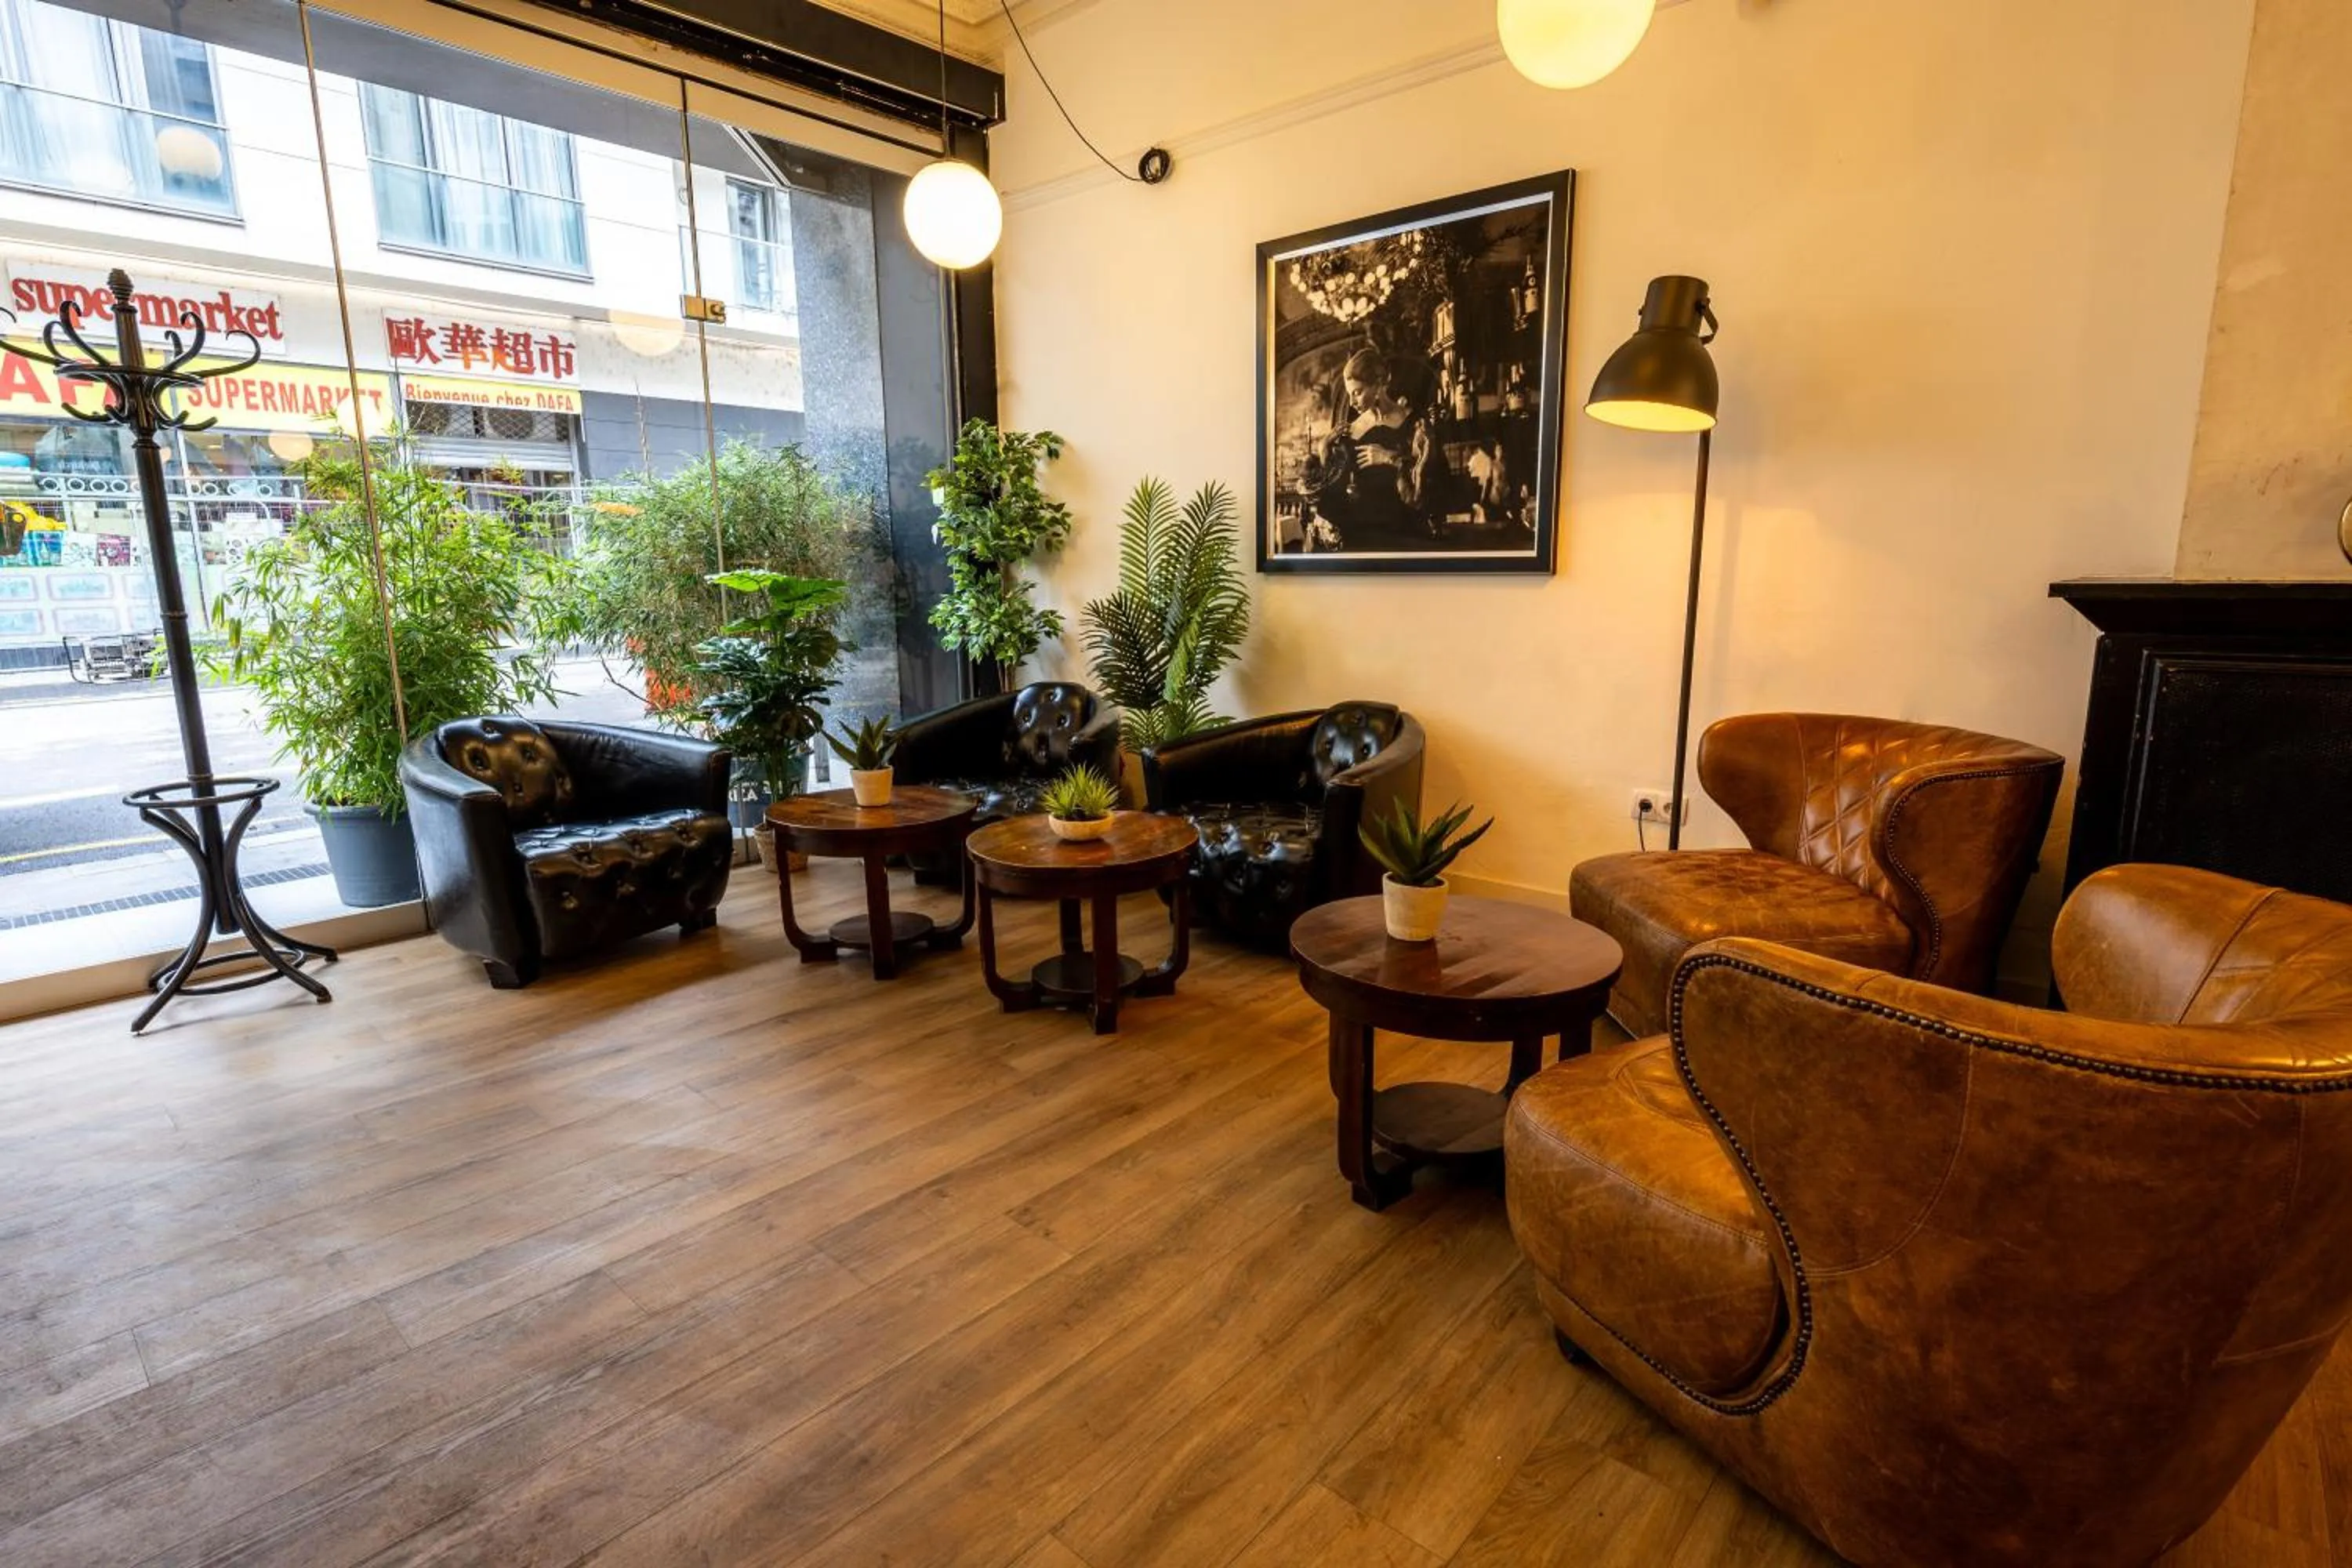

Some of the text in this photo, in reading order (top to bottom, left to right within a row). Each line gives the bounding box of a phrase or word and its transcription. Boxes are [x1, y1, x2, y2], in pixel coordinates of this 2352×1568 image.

[12, 278, 284, 340] supemarket
[387, 316, 576, 379] 歐華超市
[187, 375, 383, 415] SUPERMARKT
[536, 391, 575, 412] DAFA
